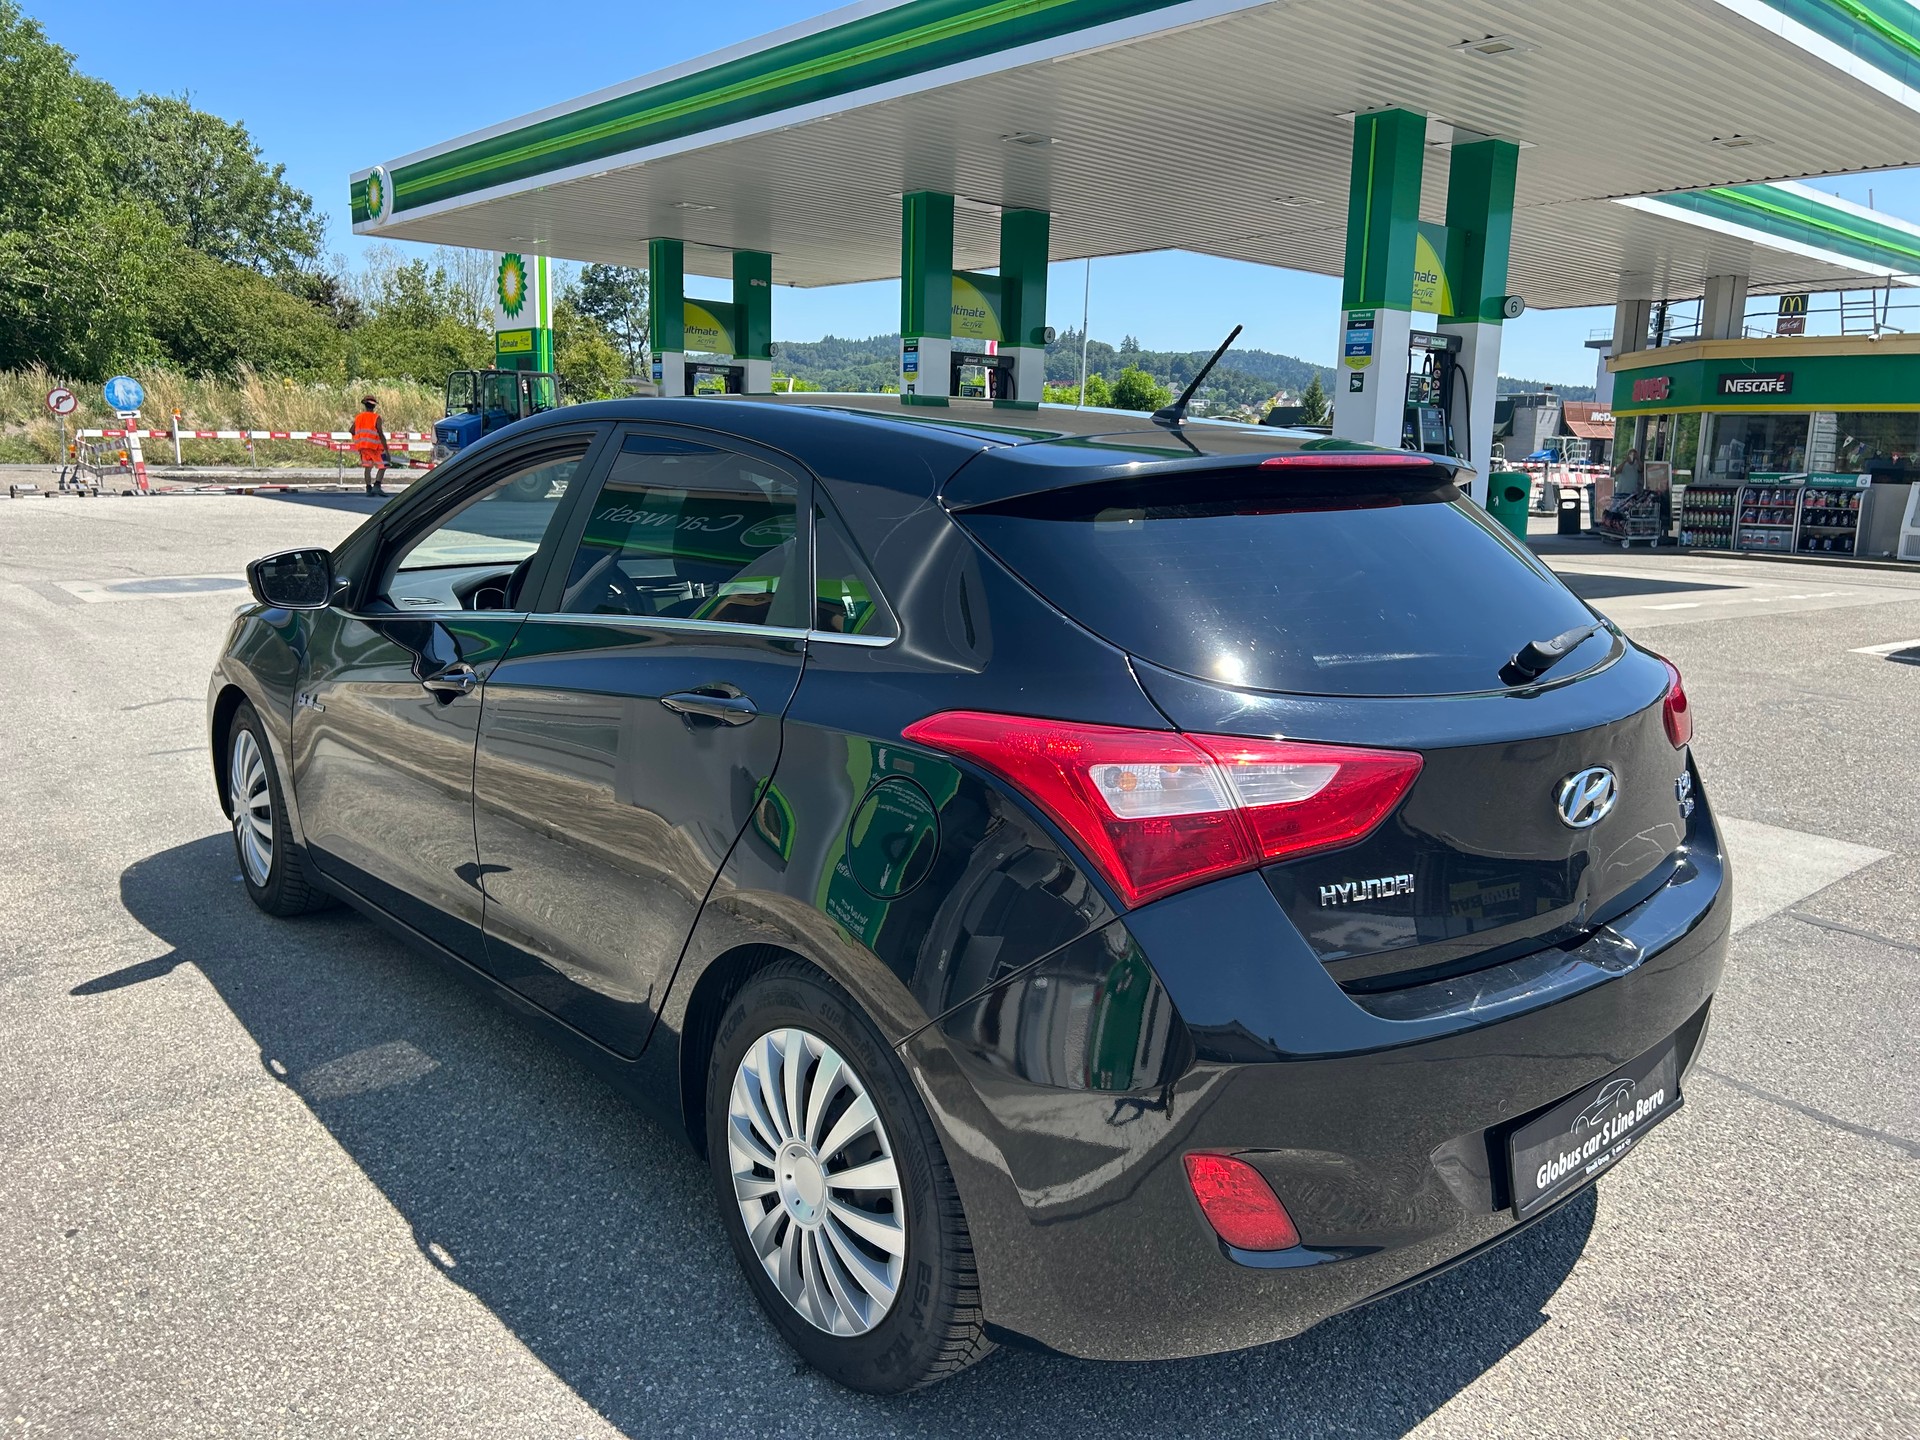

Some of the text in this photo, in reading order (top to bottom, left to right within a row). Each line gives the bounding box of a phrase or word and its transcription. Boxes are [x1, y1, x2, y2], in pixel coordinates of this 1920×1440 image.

[1414, 270, 1437, 284] mate
[1510, 301, 1517, 312] 6
[1632, 376, 1670, 402] avec
[1725, 374, 1785, 393] NESCAFÉ
[1319, 874, 1414, 906] HYUNDAI
[1536, 1147, 1580, 1188] Globus
[1582, 1132, 1602, 1157] car
[1602, 1124, 1610, 1145] S
[1612, 1113, 1634, 1139] Line
[1635, 1088, 1664, 1122] Berro
